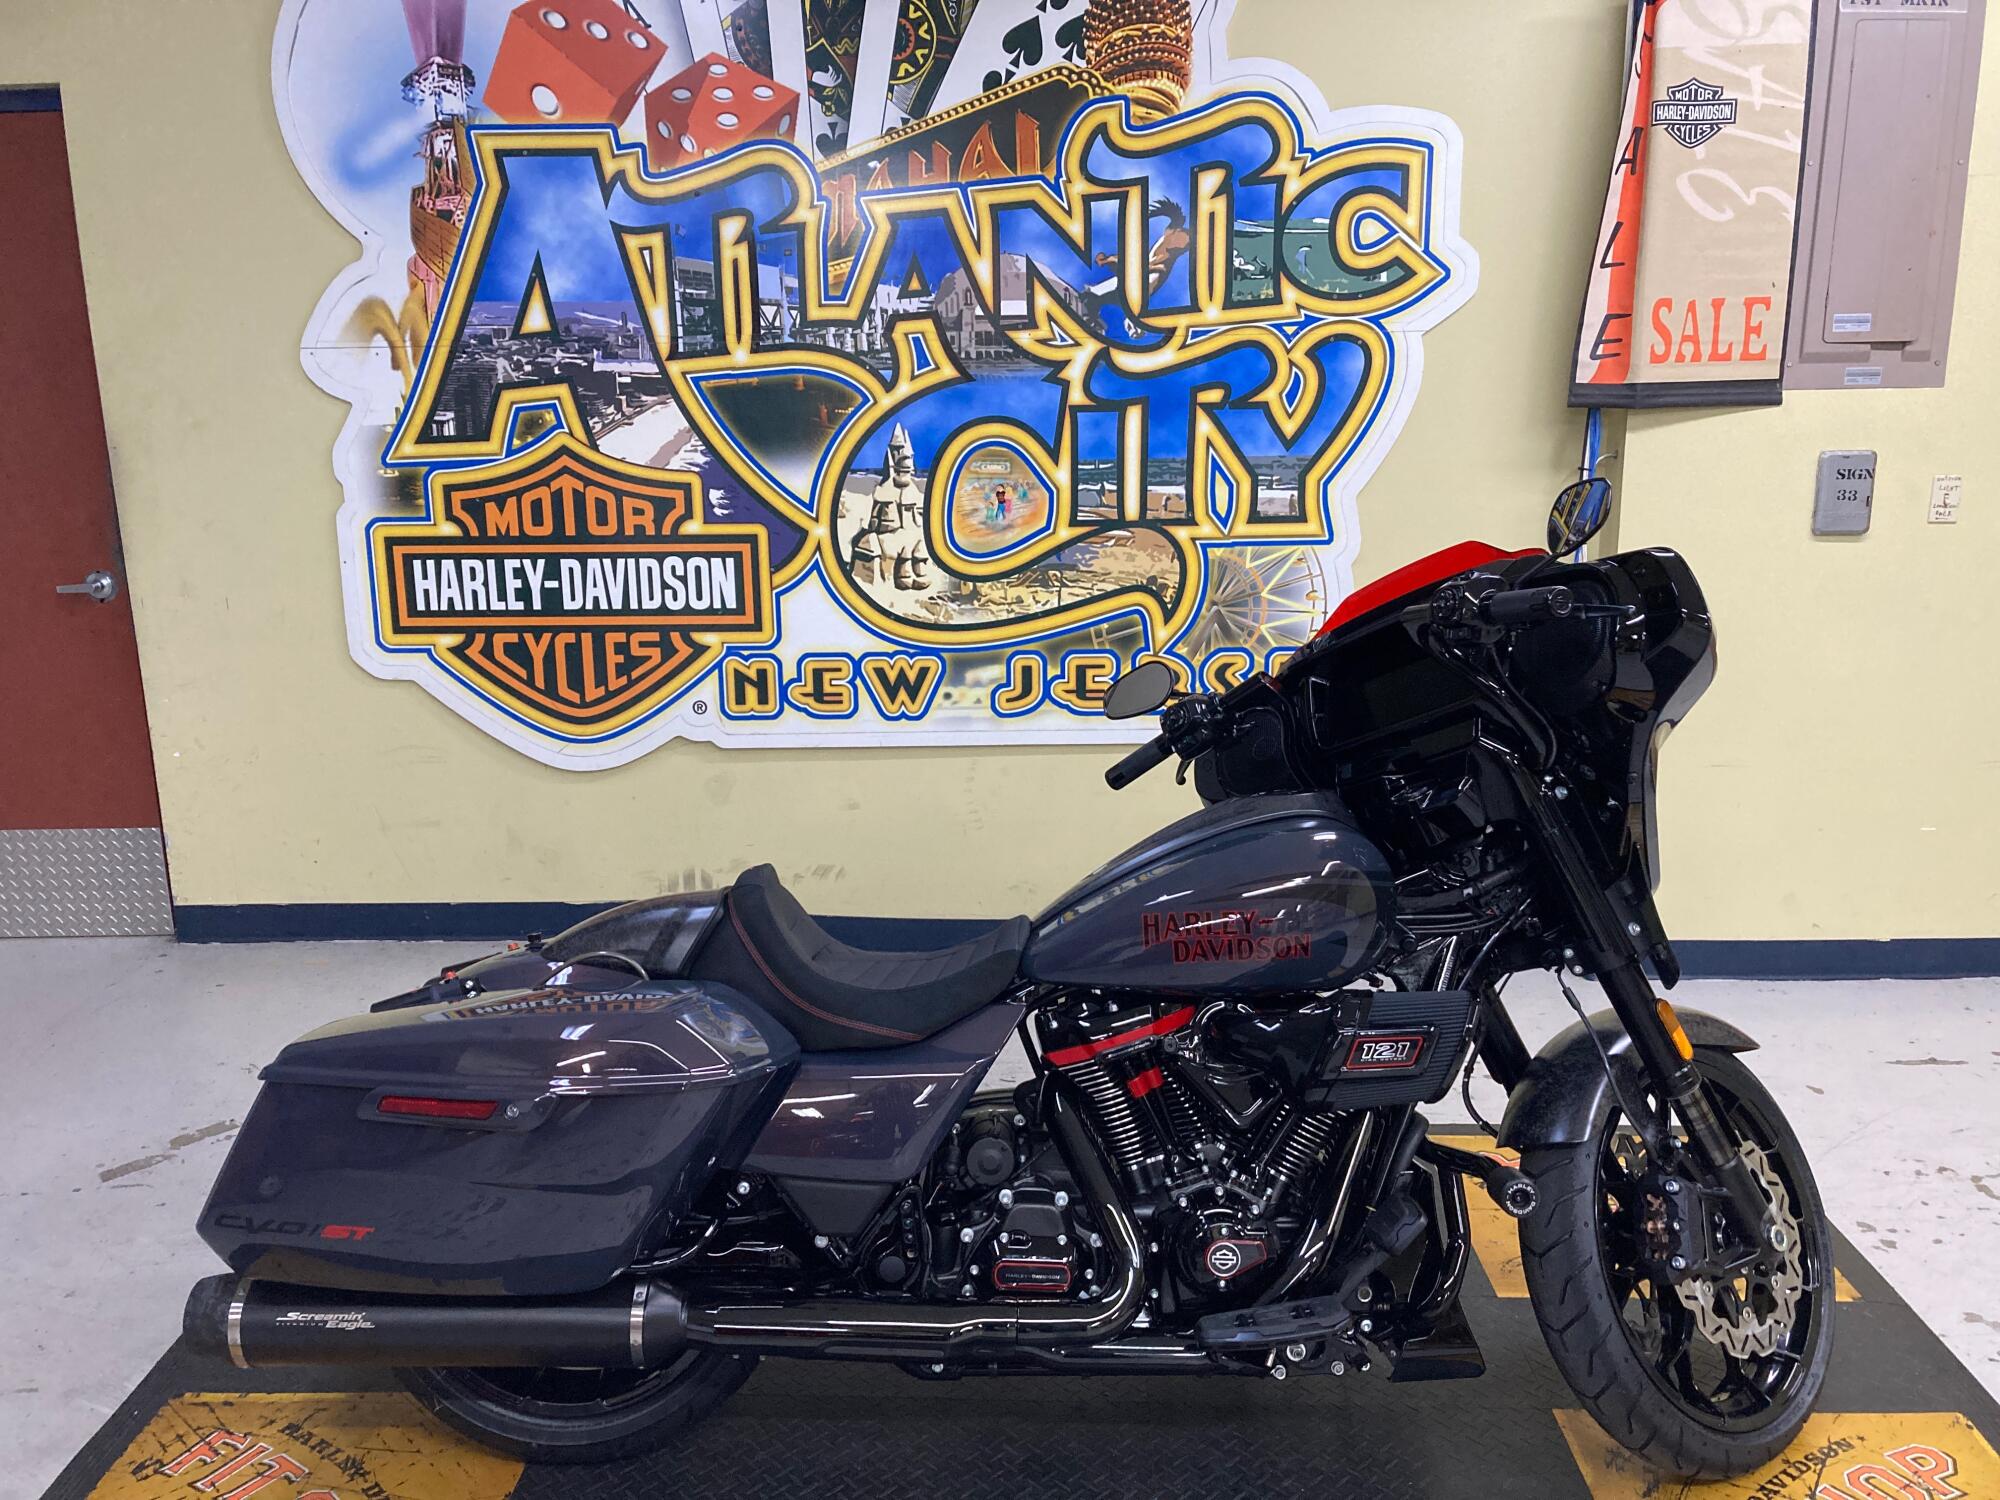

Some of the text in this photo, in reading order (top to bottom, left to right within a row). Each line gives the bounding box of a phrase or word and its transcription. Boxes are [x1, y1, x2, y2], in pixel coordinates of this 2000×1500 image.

[1675, 84, 1713, 101] MOTOR
[1656, 103, 1732, 121] HARLEY-DAVIDSON
[1673, 124, 1711, 143] CYCLES
[383, 92, 1450, 467] ATLANTIC
[1649, 296, 1772, 365] SALE
[812, 318, 1394, 654] CITY
[1836, 468, 1875, 481] SIGN
[486, 473, 656, 537] MOTOR
[1836, 489, 1858, 502] 33
[412, 555, 737, 612] HARLEY-DAVIDSON
[492, 630, 662, 704] CYCLES
[722, 652, 944, 720] NEW
[1172, 933, 1312, 965] DAVIDSON
[1361, 1041, 1411, 1059] 121
[320, 1224, 376, 1241] ST
[276, 1312, 366, 1321] Screamin'
[325, 1319, 376, 1331] Eagle
[158, 1427, 310, 1500] FIT
[1812, 1444, 1968, 1500] OP
